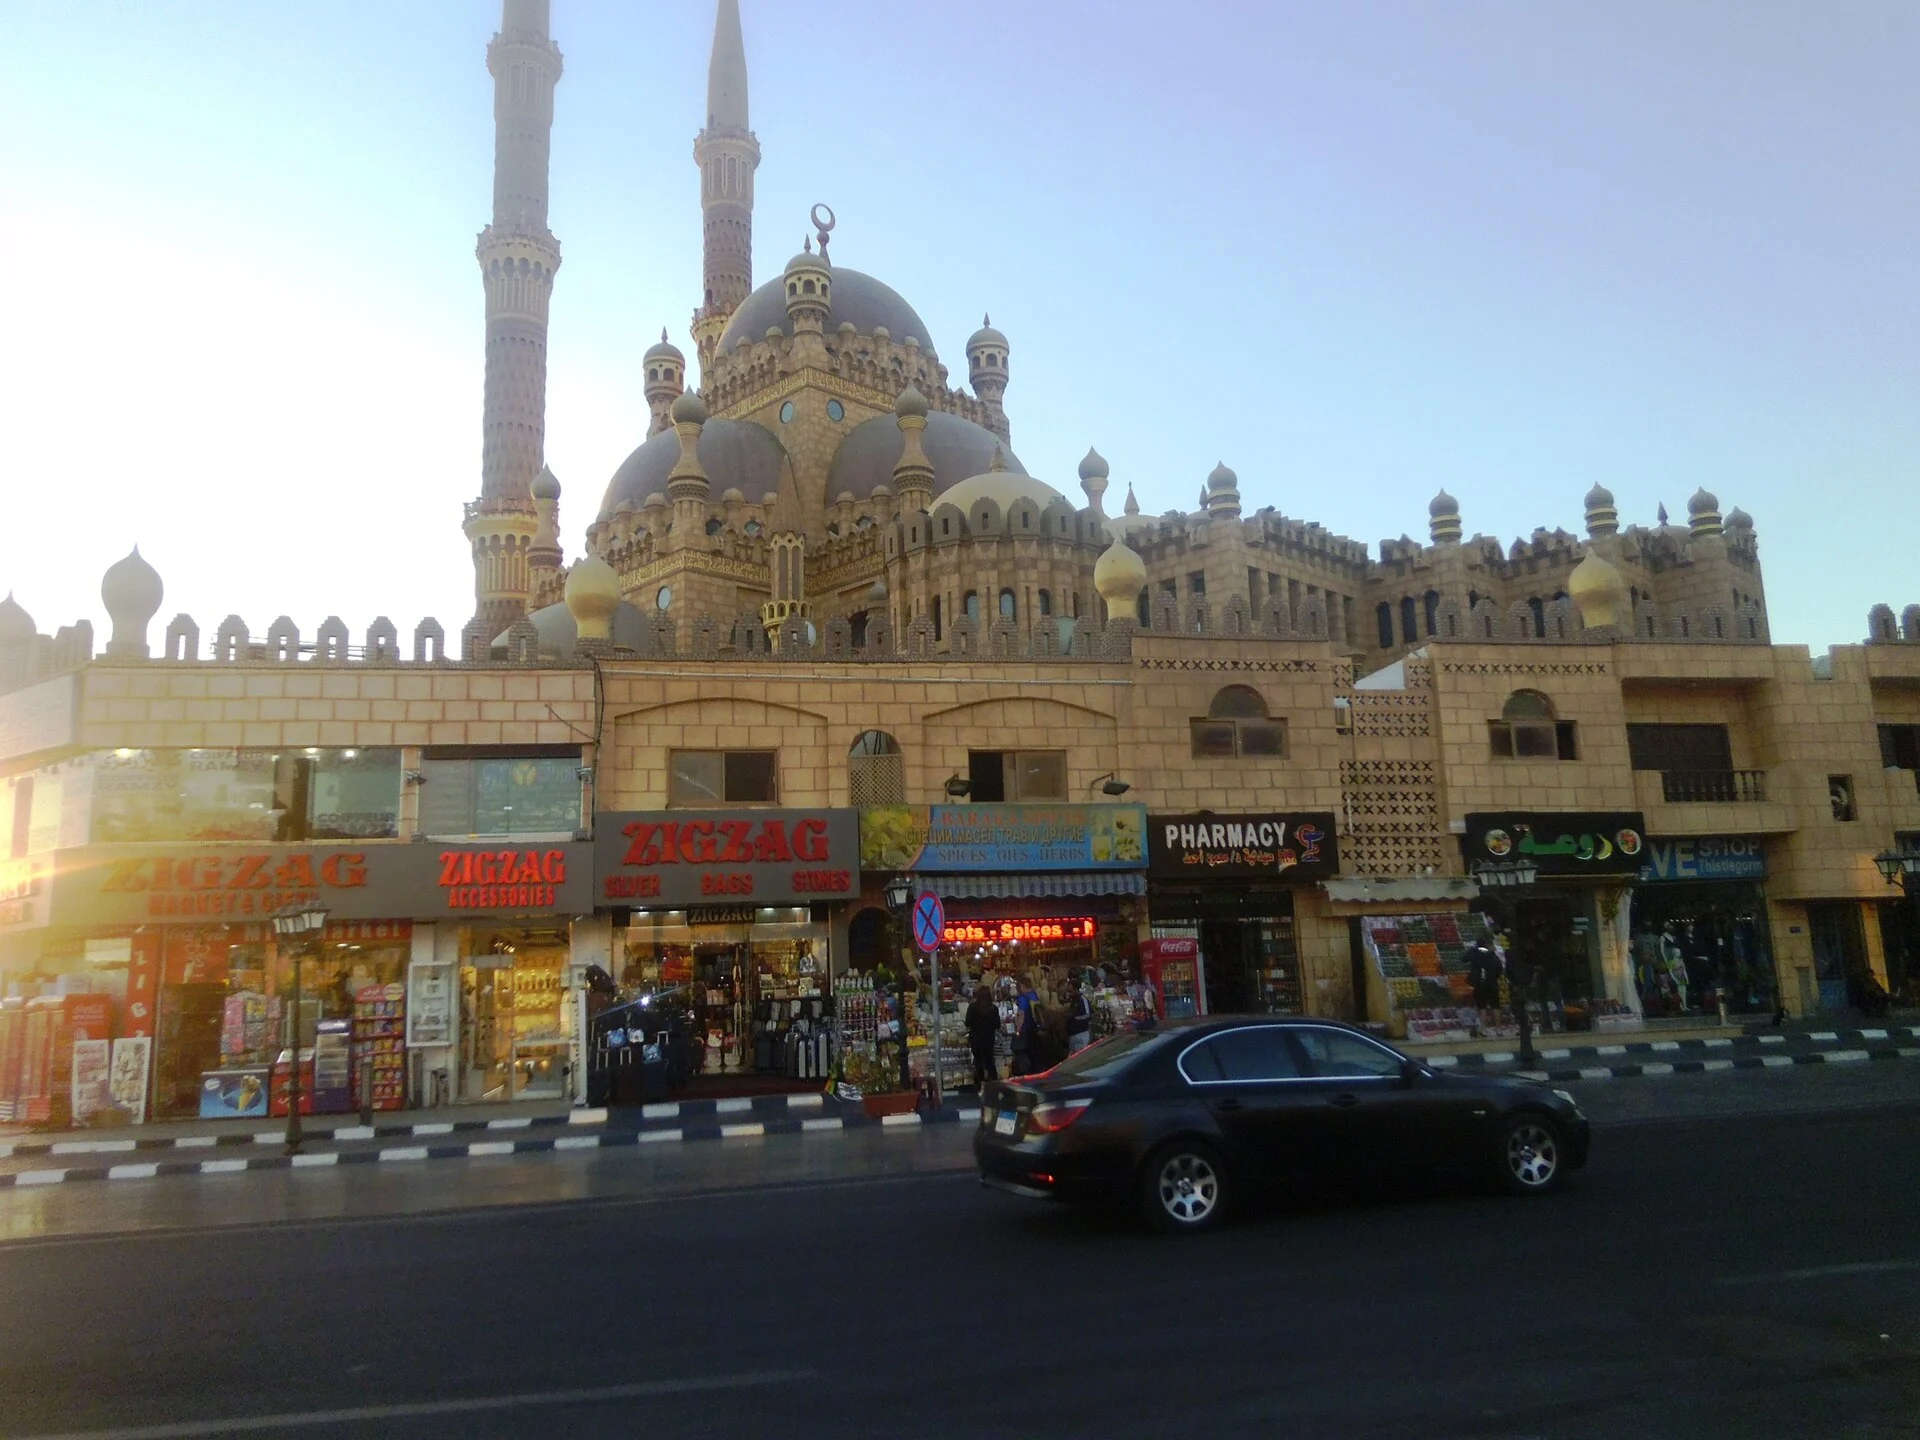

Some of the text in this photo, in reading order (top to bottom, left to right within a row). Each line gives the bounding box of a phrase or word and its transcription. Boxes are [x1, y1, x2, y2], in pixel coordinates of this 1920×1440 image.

[622, 818, 830, 866] ZIGZAG
[1042, 826, 1085, 847] ДРУГИЕ
[1165, 822, 1286, 849] PHARMACY
[1040, 847, 1086, 862] HERBS
[1647, 838, 1760, 877] VE SHOP
[1699, 858, 1763, 875] Thistlegorm
[100, 852, 368, 892] ZIGZAG
[438, 849, 566, 886] ZIGZAG
[448, 885, 555, 908] ACCESSORIES
[605, 869, 851, 899] SILVER BAGS STONES
[690, 906, 754, 922] ZIGZAG
[944, 924, 985, 940] eets
[1001, 922, 1062, 940] Spices
